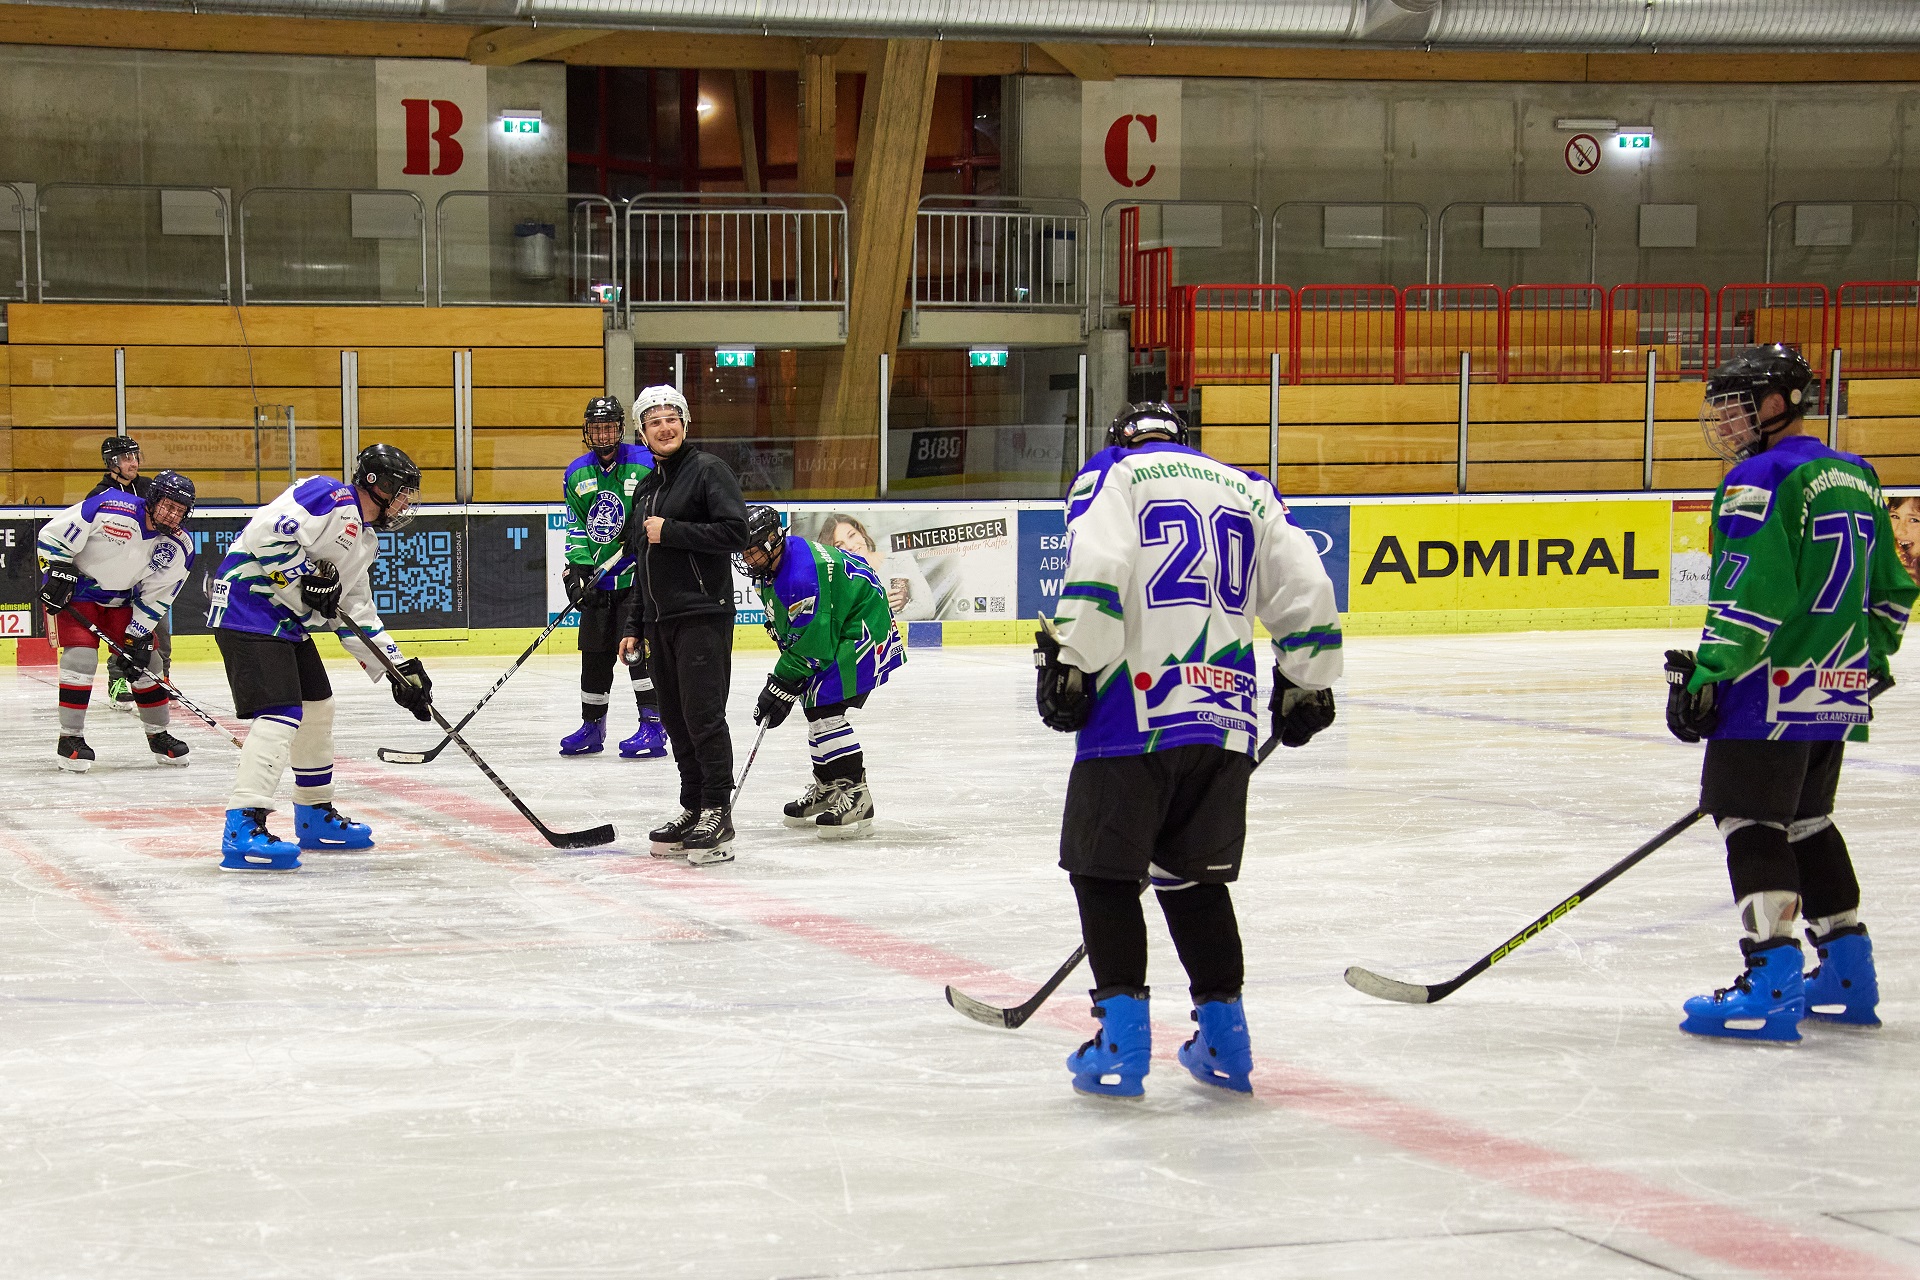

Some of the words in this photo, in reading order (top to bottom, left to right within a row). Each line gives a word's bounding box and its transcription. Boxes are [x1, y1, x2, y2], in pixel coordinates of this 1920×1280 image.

[401, 98, 464, 176] B
[1104, 114, 1157, 188] C
[1138, 499, 1257, 616] 20
[1360, 531, 1660, 585] ADMIRAL
[1490, 895, 1581, 965] FISCHER
